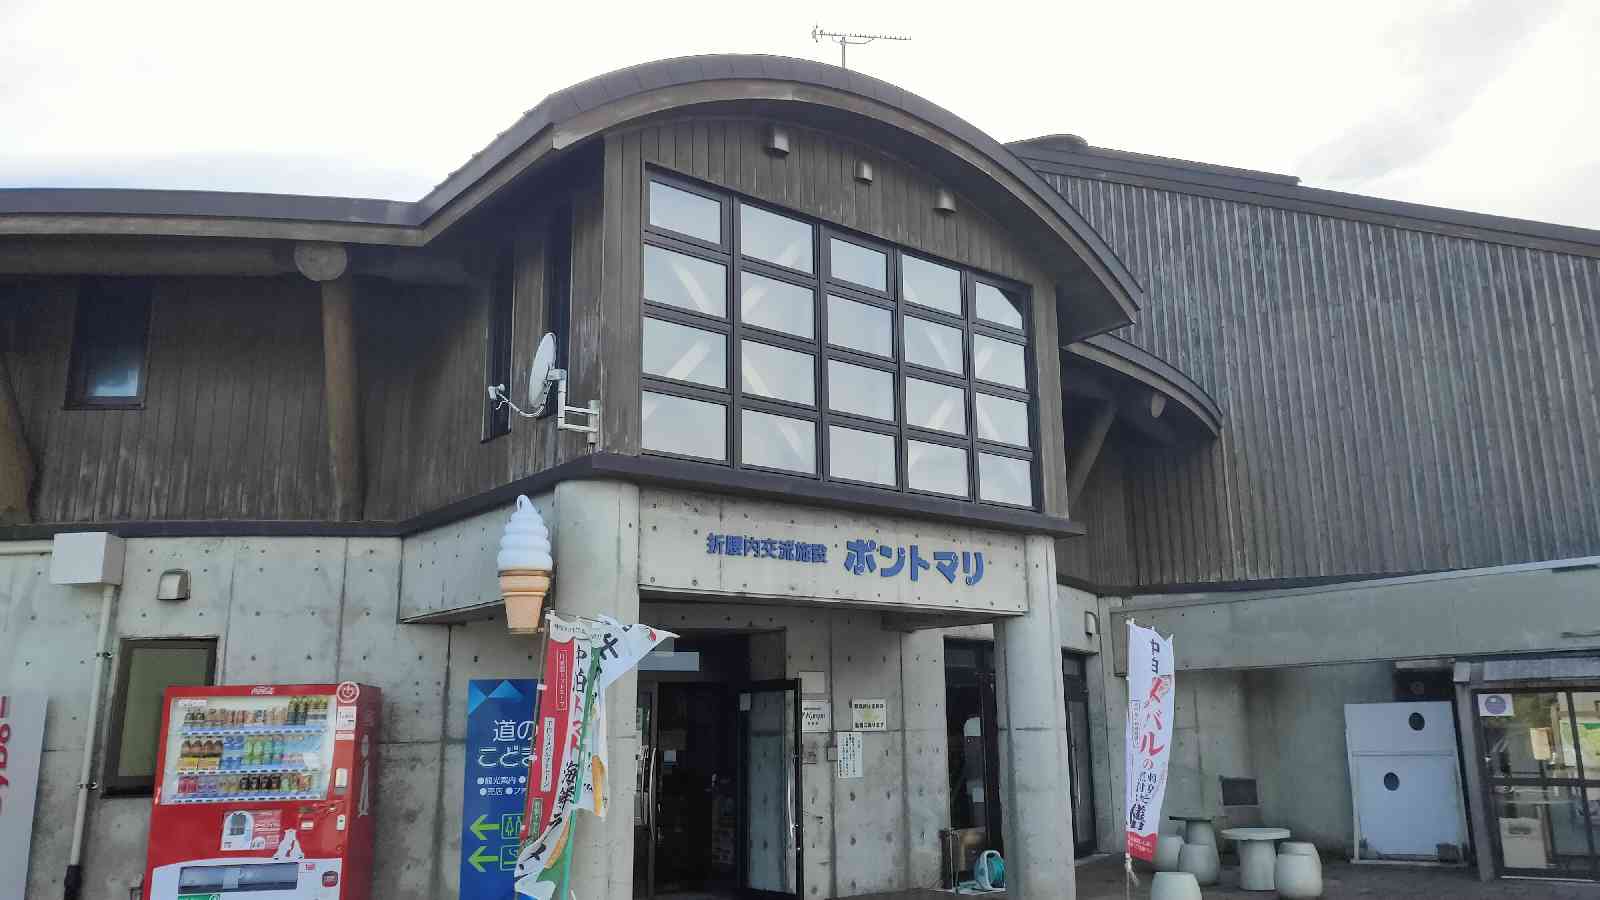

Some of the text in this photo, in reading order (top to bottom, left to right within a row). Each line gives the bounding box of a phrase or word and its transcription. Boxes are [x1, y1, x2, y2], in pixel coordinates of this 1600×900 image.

[843, 539, 984, 586] ポントマリ
[493, 719, 536, 742] 道の
